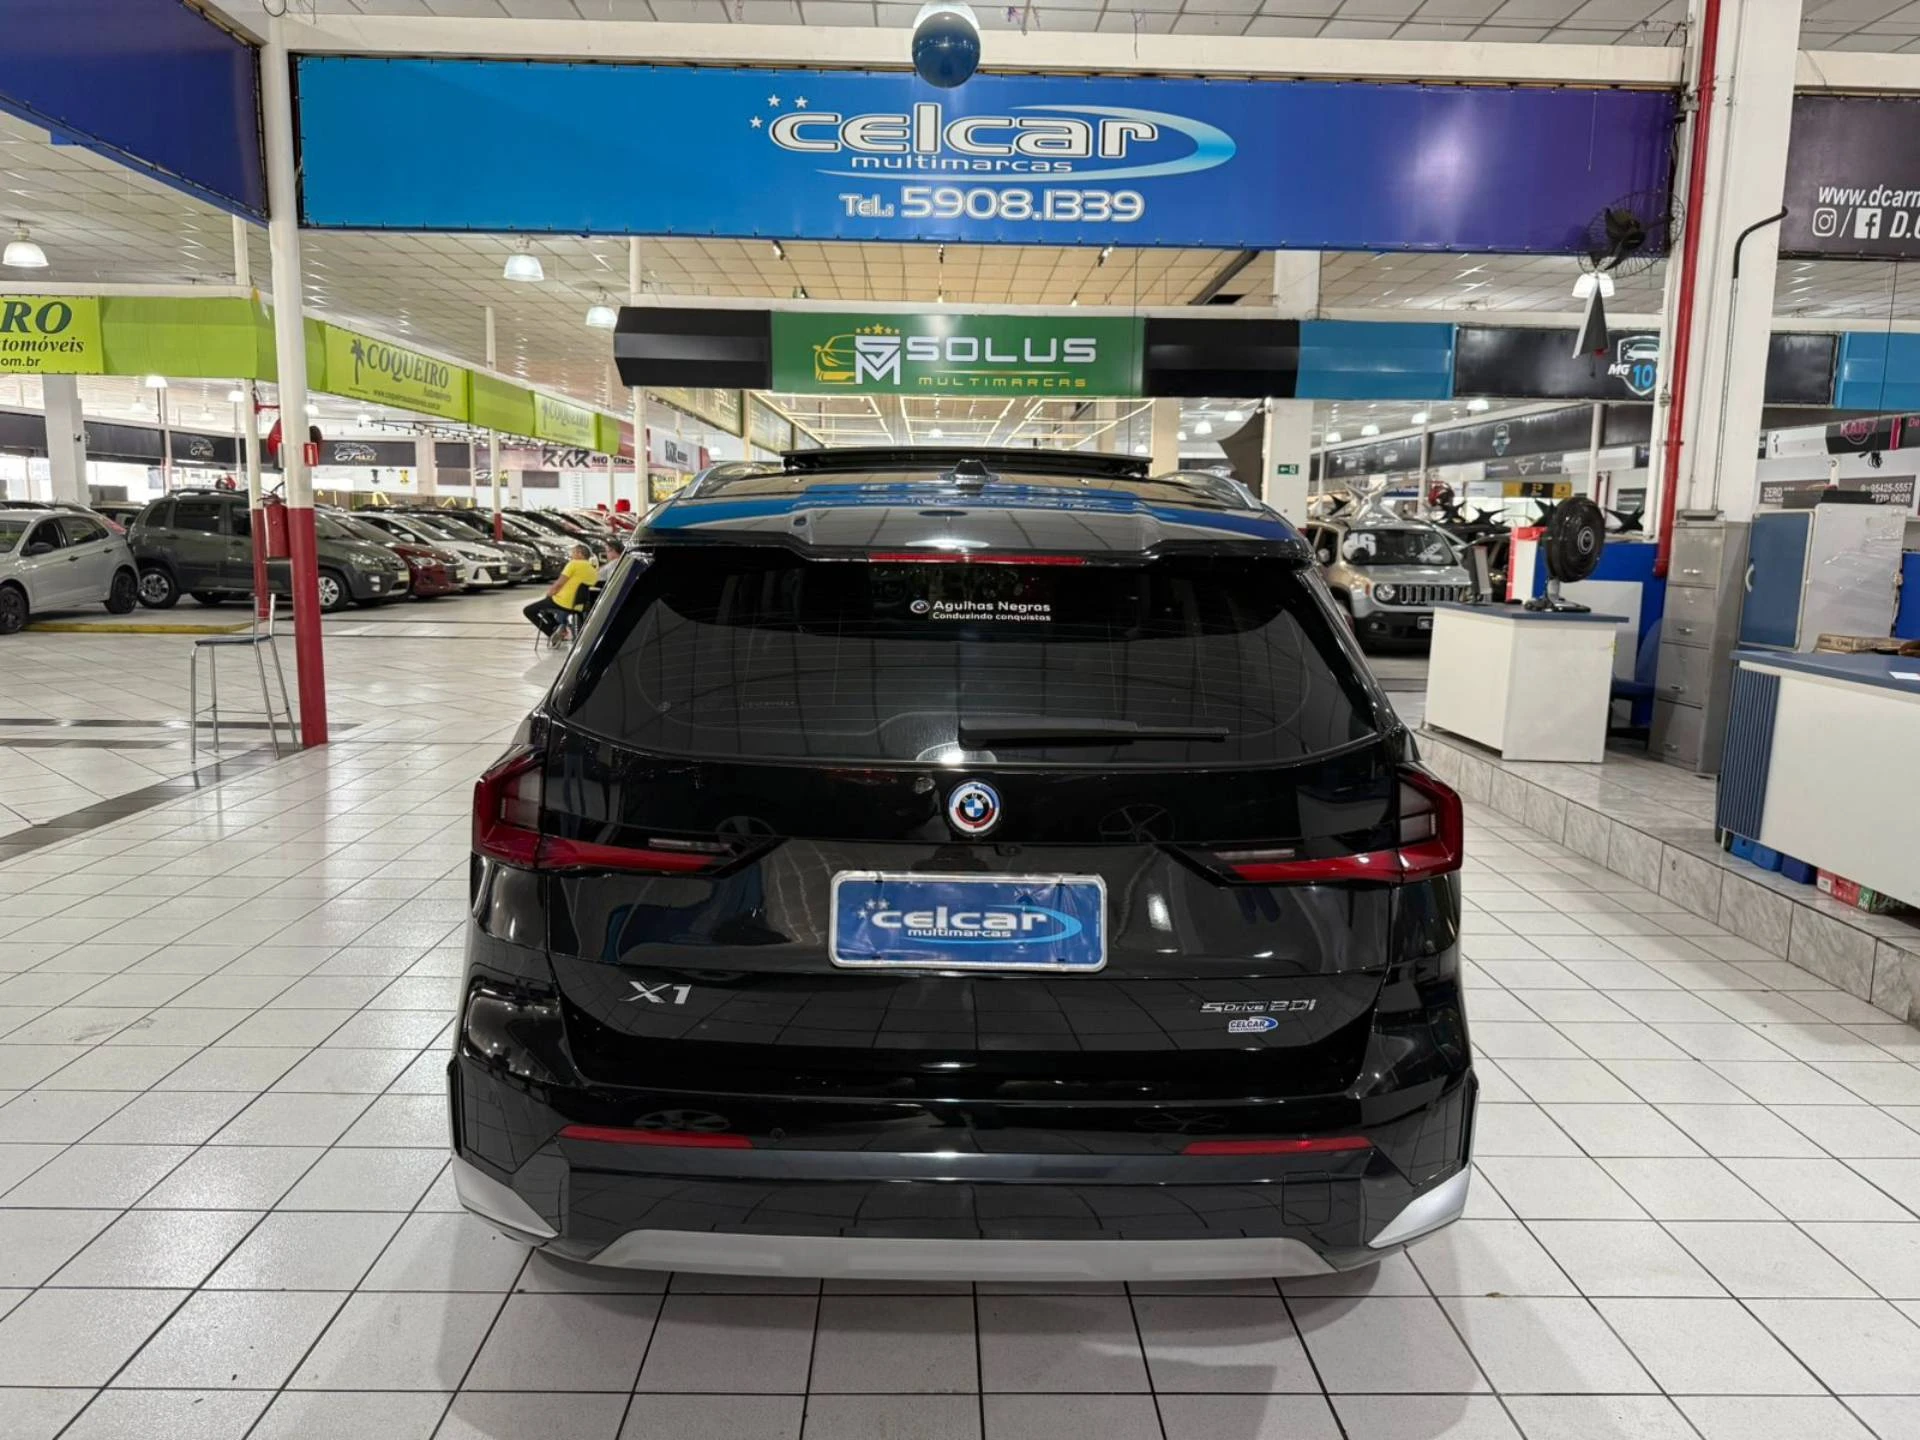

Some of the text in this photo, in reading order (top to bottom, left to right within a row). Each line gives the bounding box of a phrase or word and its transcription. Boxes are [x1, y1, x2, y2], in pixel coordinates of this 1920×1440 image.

[769, 102, 1158, 158] celcar
[851, 155, 1073, 173] multimarcas
[900, 185, 1146, 222] 5908.1339
[906, 336, 1097, 363] SOLUS
[366, 343, 449, 389] COQUEIRO
[1607, 364, 1631, 375] MG
[918, 377, 1087, 387] MULTIMARCAS
[933, 600, 1051, 613] Agulhas Negras
[933, 611, 1051, 622] Conduzindo conquistas
[872, 906, 1047, 931] celcar
[908, 927, 1012, 938] multimarcas
[618, 981, 692, 1005] X1
[1230, 1020, 1265, 1028] CELCAR
